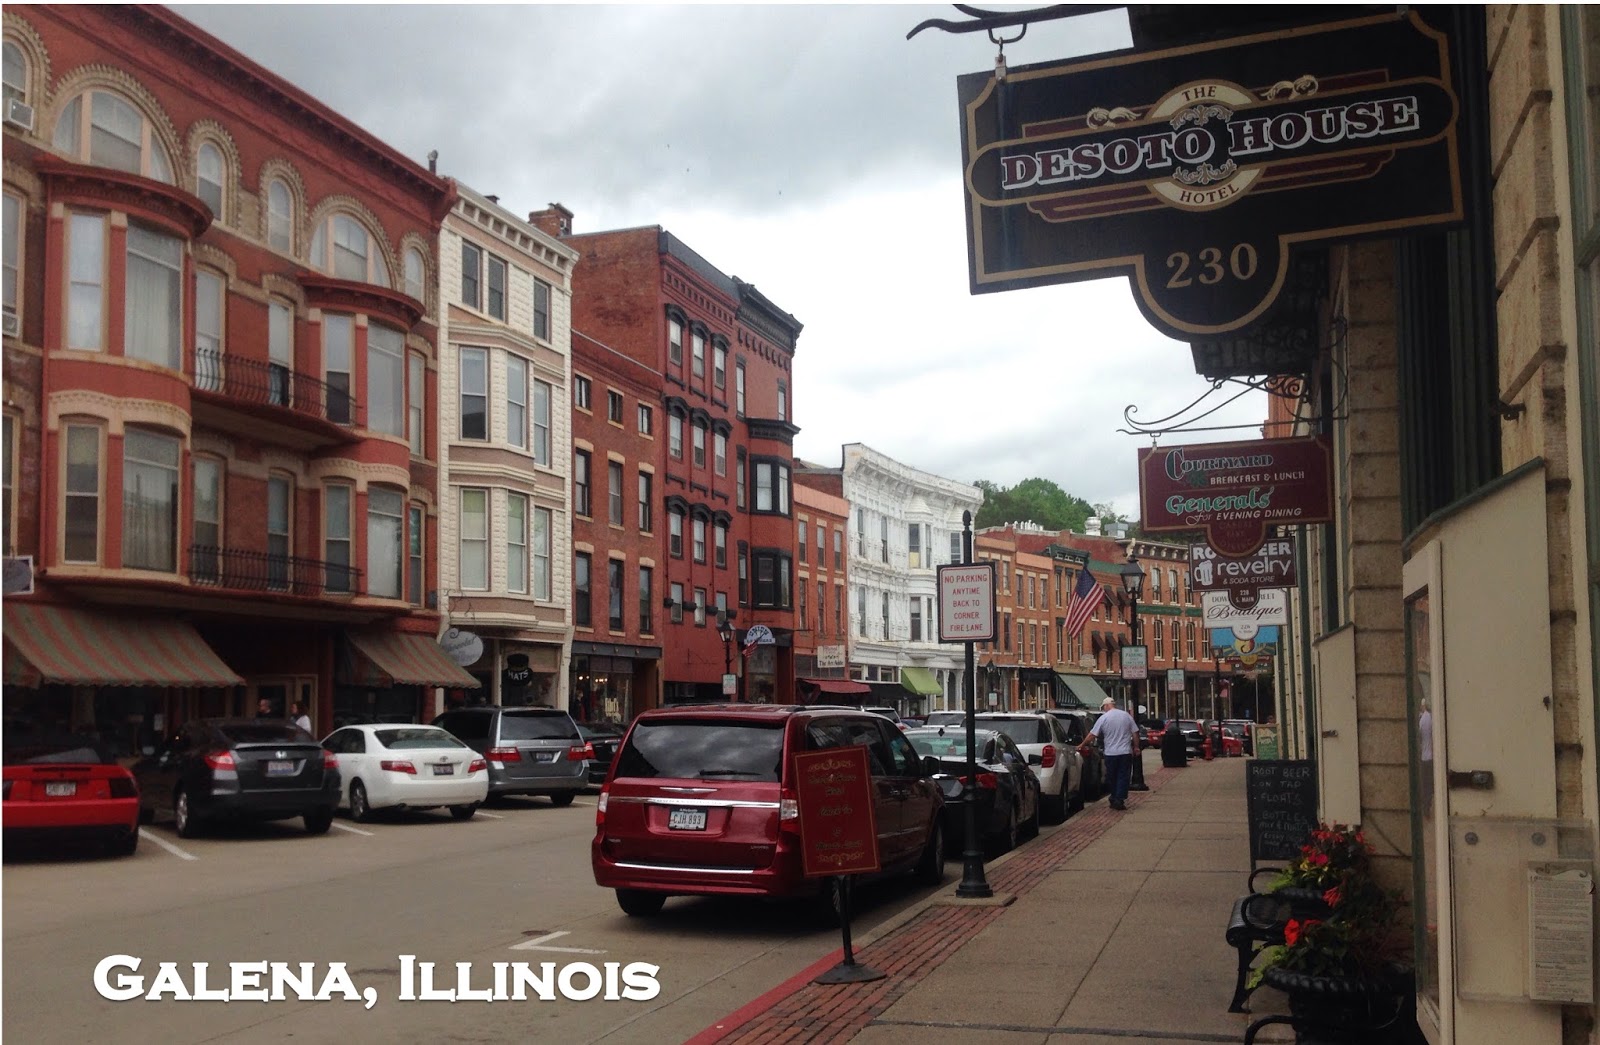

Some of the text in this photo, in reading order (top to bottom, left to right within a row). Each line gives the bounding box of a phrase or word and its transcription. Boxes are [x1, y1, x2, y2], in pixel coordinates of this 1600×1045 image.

[1181, 84, 1217, 101] THE
[1001, 95, 1420, 190] DESOTO HOUSE
[1179, 181, 1239, 204] HOTEL
[1165, 243, 1259, 289] 230
[1165, 447, 1274, 481] COURTYARD
[1210, 471, 1305, 485] BREAKFAST & LUNCH
[1186, 508, 1302, 526] For EVENING DINING
[1193, 542, 1292, 560] RO EER
[1217, 556, 1292, 576] revelry
[944, 574, 988, 584] NO PARKING
[1229, 577, 1249, 585] SODA
[1250, 575, 1275, 584] STORE
[952, 587, 980, 596] ANYTIME
[953, 599, 980, 608] BACK TO
[953, 611, 980, 620] CORNER
[950, 623, 983, 632] FIRE LANE
[508, 669, 529, 681] HATS
[1252, 766, 1311, 778] ROOT BEER
[1279, 780, 1301, 789] TAP
[688, 814, 702, 825] 893
